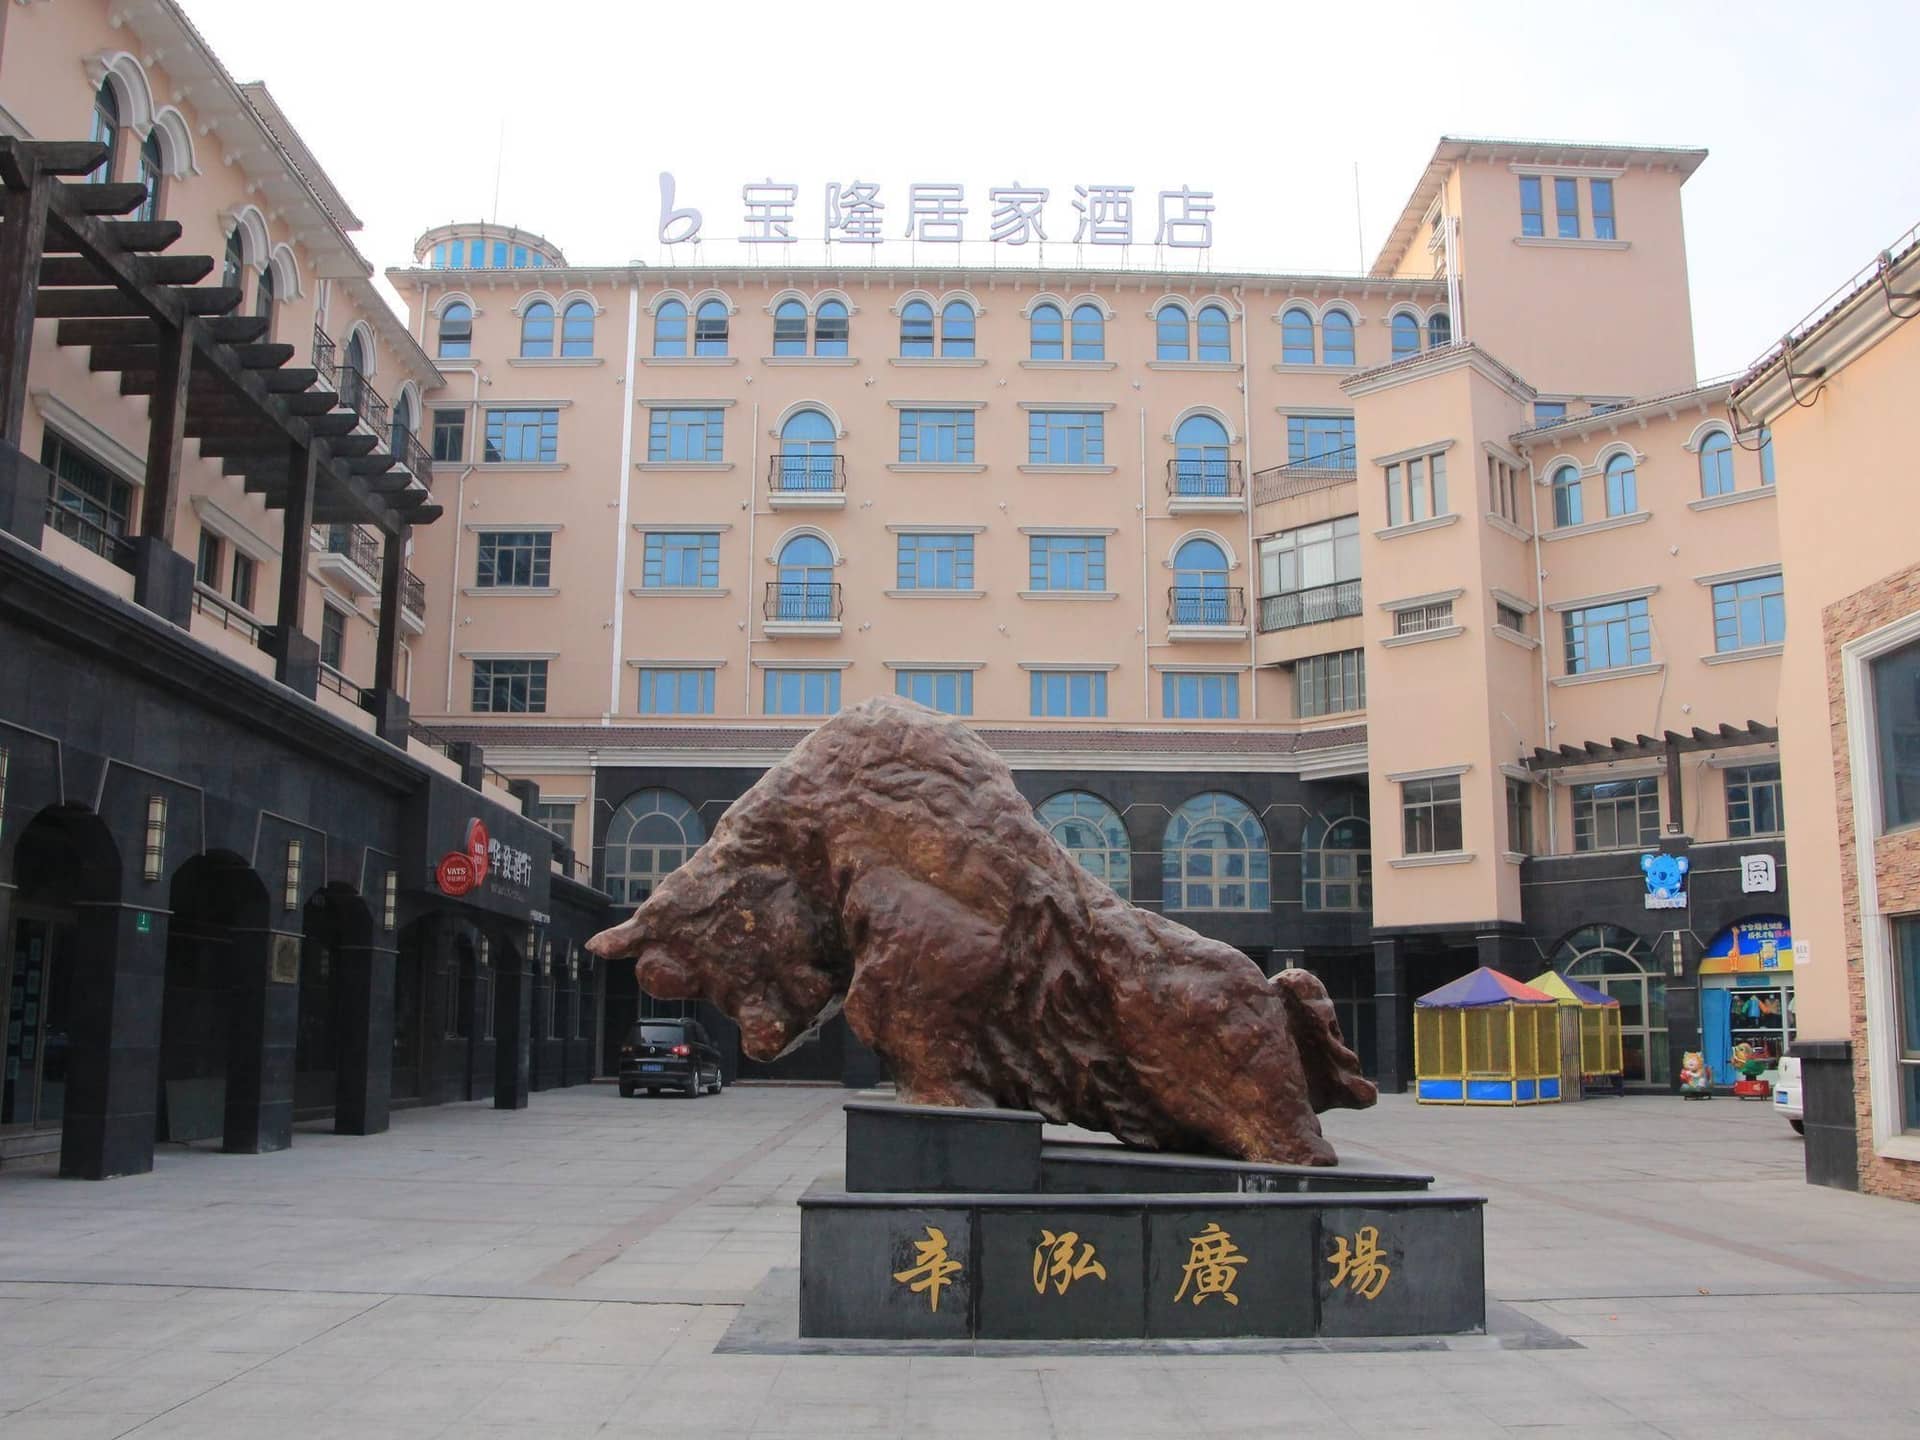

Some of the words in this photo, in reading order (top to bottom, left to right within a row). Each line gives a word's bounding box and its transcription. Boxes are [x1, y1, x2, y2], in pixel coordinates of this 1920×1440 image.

[738, 178, 1216, 248] 宝隆居家酒店
[447, 867, 467, 876] VATS
[893, 1222, 1392, 1313] 辛泓廣場
